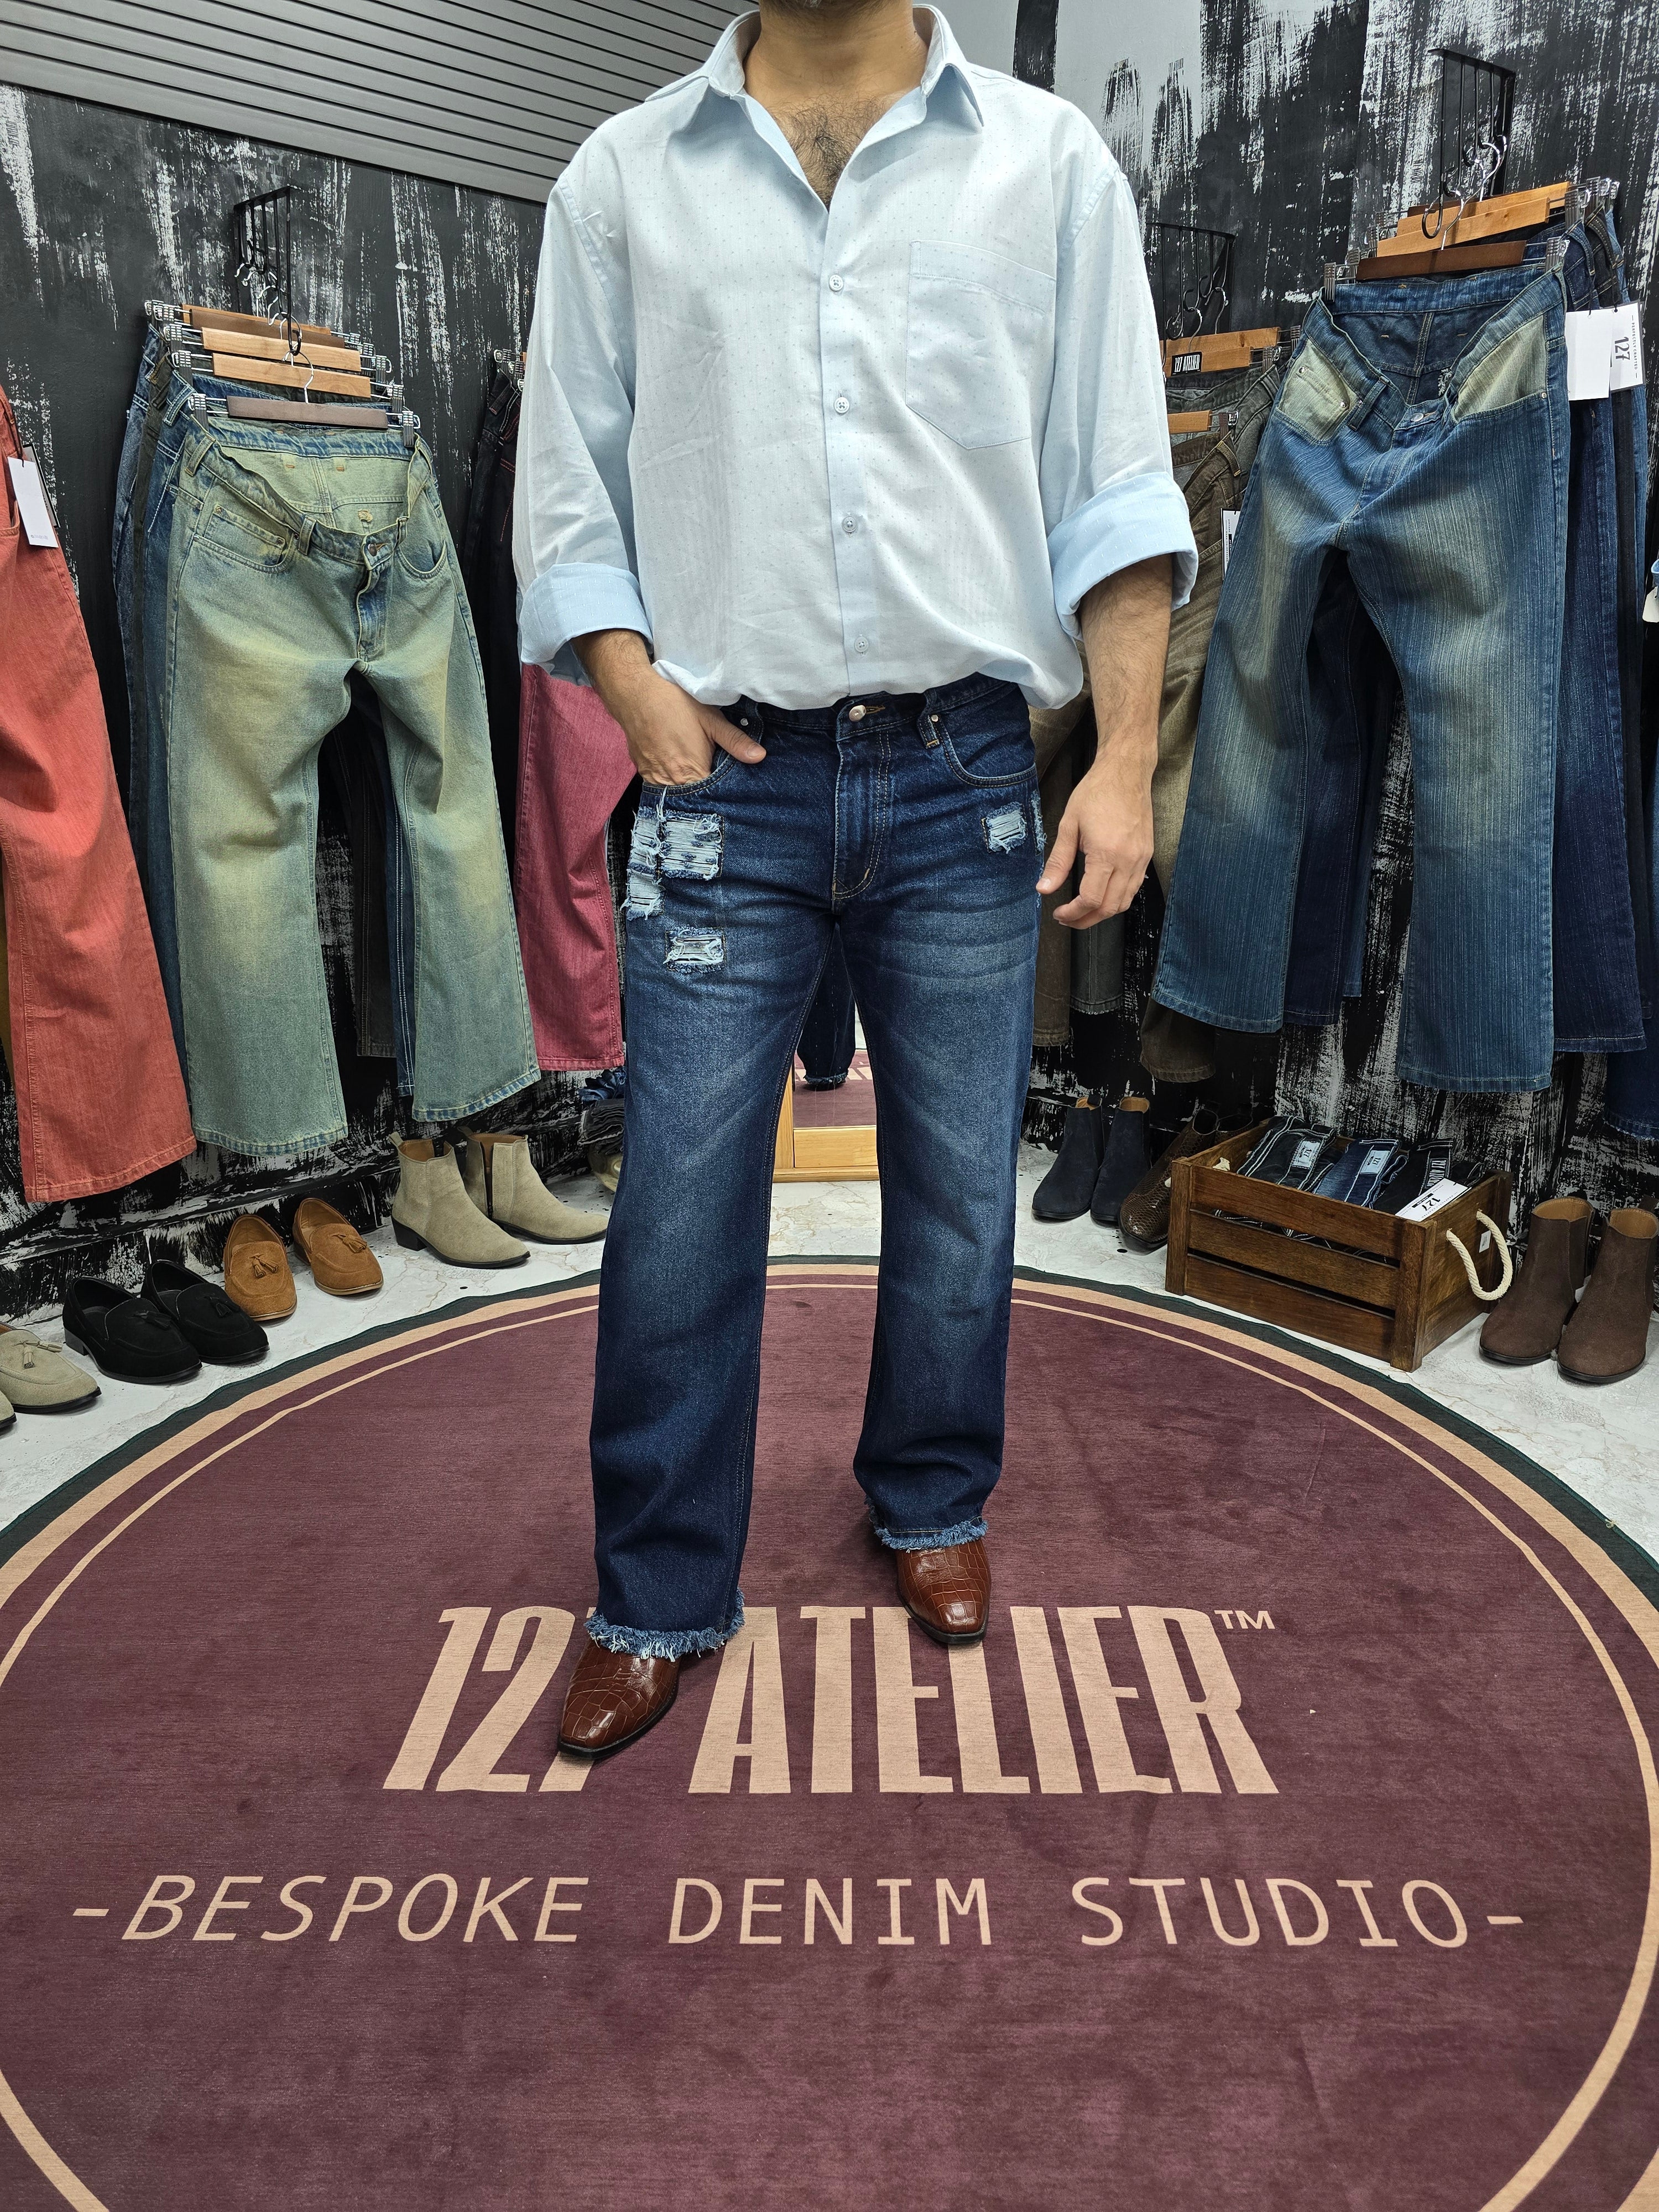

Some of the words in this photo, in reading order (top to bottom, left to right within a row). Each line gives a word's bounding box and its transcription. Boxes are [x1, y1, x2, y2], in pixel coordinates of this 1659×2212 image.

[1614, 336, 1630, 361] 127
[1421, 1197, 1441, 1211] 127
[382, 1606, 597, 1792] 12
[688, 1605, 1279, 1794] ATELIER
[668, 1877, 992, 1945] DENIM
